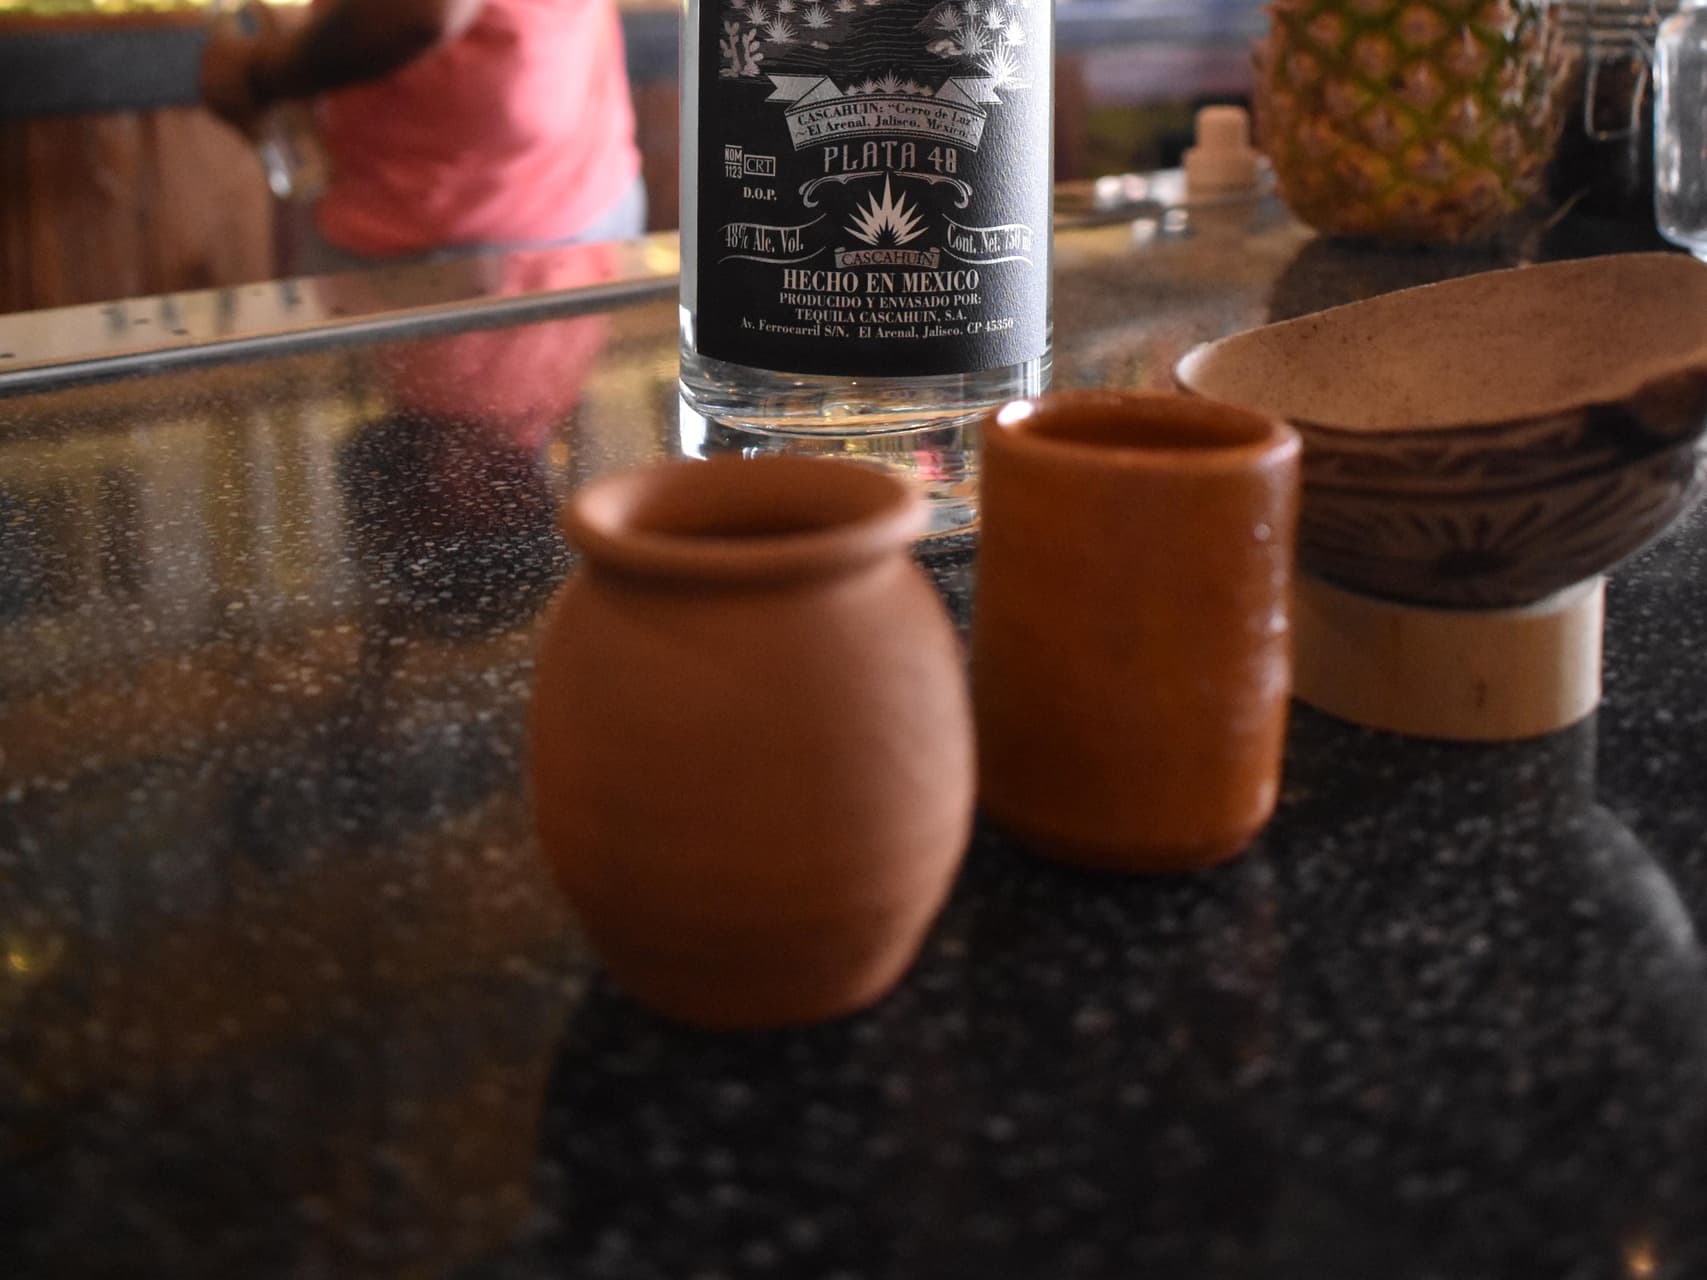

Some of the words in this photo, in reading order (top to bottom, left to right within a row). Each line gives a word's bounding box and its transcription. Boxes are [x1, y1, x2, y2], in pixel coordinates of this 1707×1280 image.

[806, 123, 822, 136] El
[724, 148, 743, 162] NOM
[823, 140, 916, 173] PLATA
[927, 145, 957, 173] 48
[724, 165, 743, 179] 1123
[746, 158, 773, 173] CRT
[743, 186, 777, 201] D.O.P.
[780, 227, 804, 254] Vol.
[783, 268, 859, 293] HECHO
[865, 272, 896, 293] EN
[901, 268, 979, 293] MEXICO
[780, 291, 862, 309] PRODUCIDO
[866, 296, 876, 309] Y
[880, 295, 950, 309] ENVASADO
[954, 293, 982, 306] POR:
[795, 307, 856, 323] TEQUILA
[945, 309, 967, 321] S.A.
[741, 316, 756, 330] Av.
[759, 319, 821, 337] Ferrocarril
[859, 326, 872, 338] El
[966, 321, 983, 335] CP
